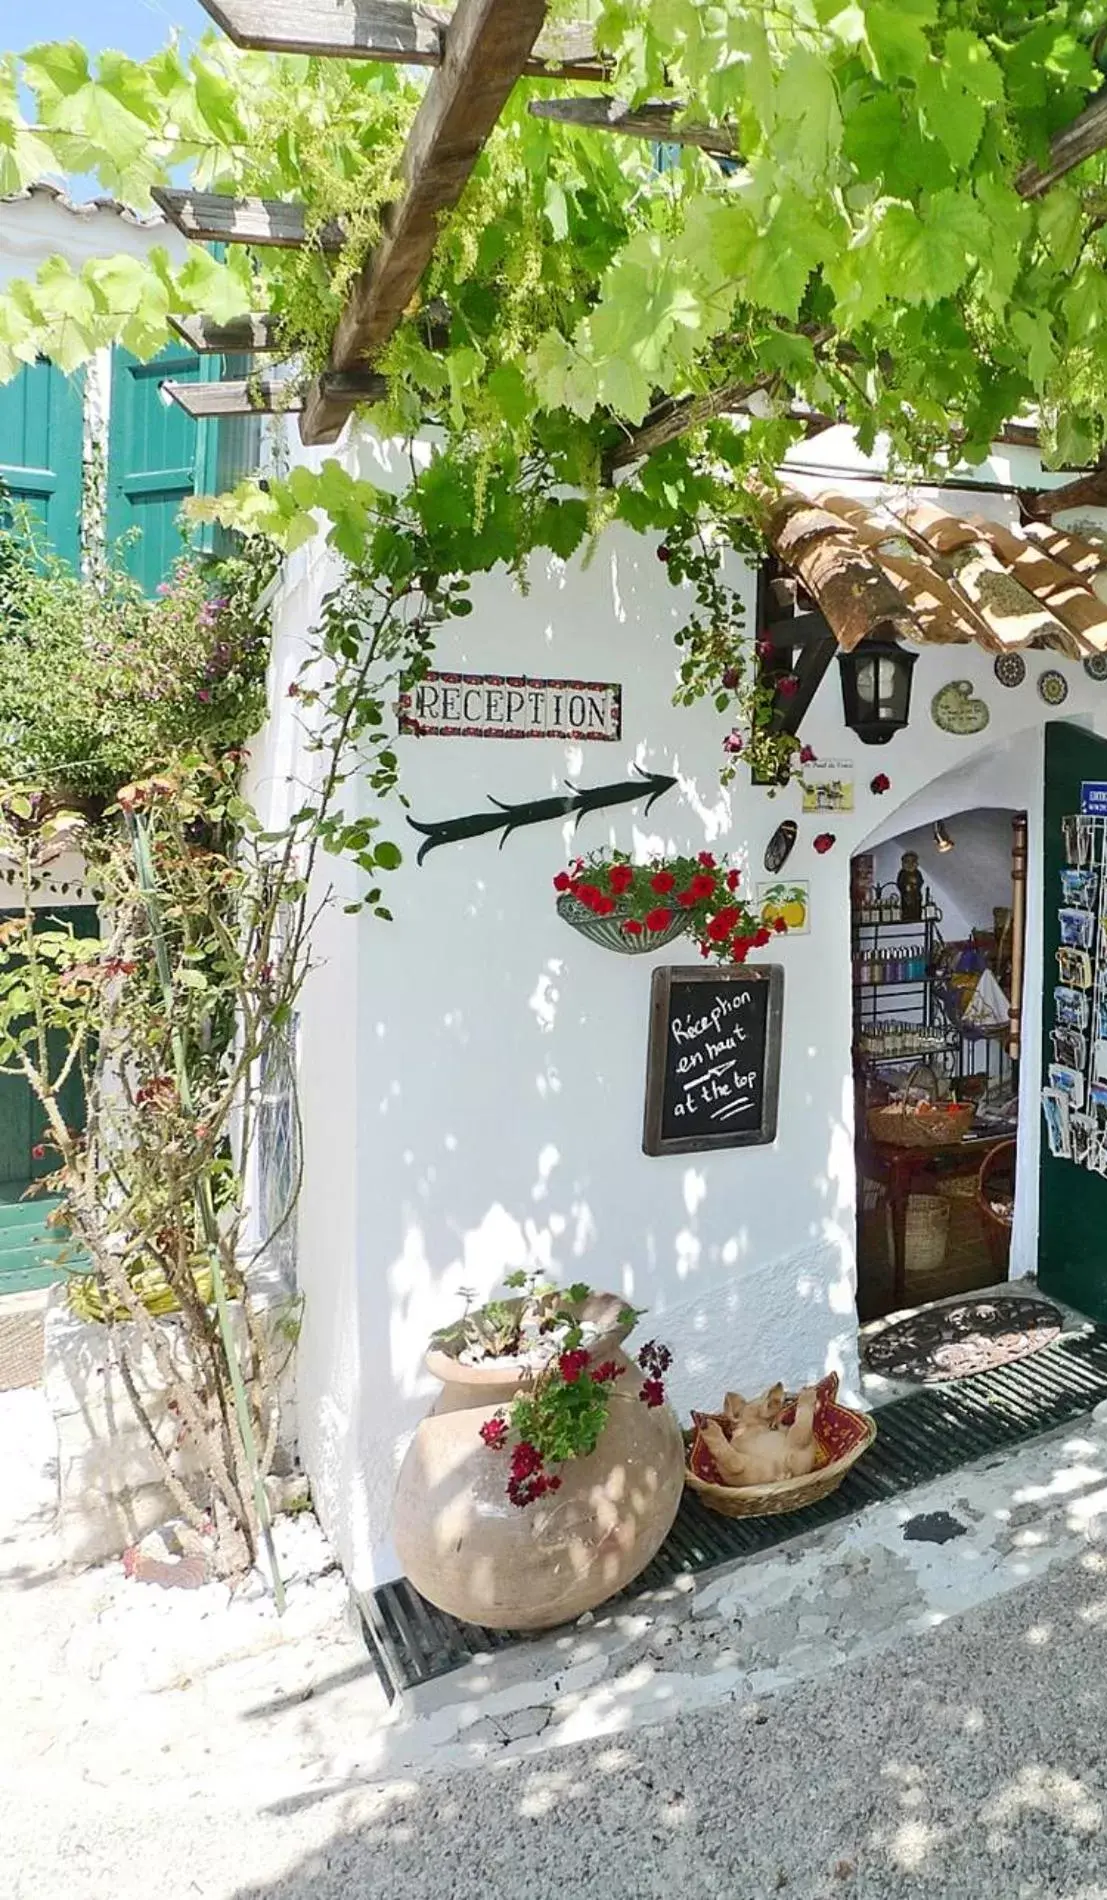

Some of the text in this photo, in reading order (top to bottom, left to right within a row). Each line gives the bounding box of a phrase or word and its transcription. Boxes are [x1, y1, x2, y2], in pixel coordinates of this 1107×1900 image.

[417, 684, 606, 728] RECEPTION
[671, 991, 751, 1044] Réception
[676, 1023, 746, 1073] en haut
[673, 1070, 757, 1117] at the top
